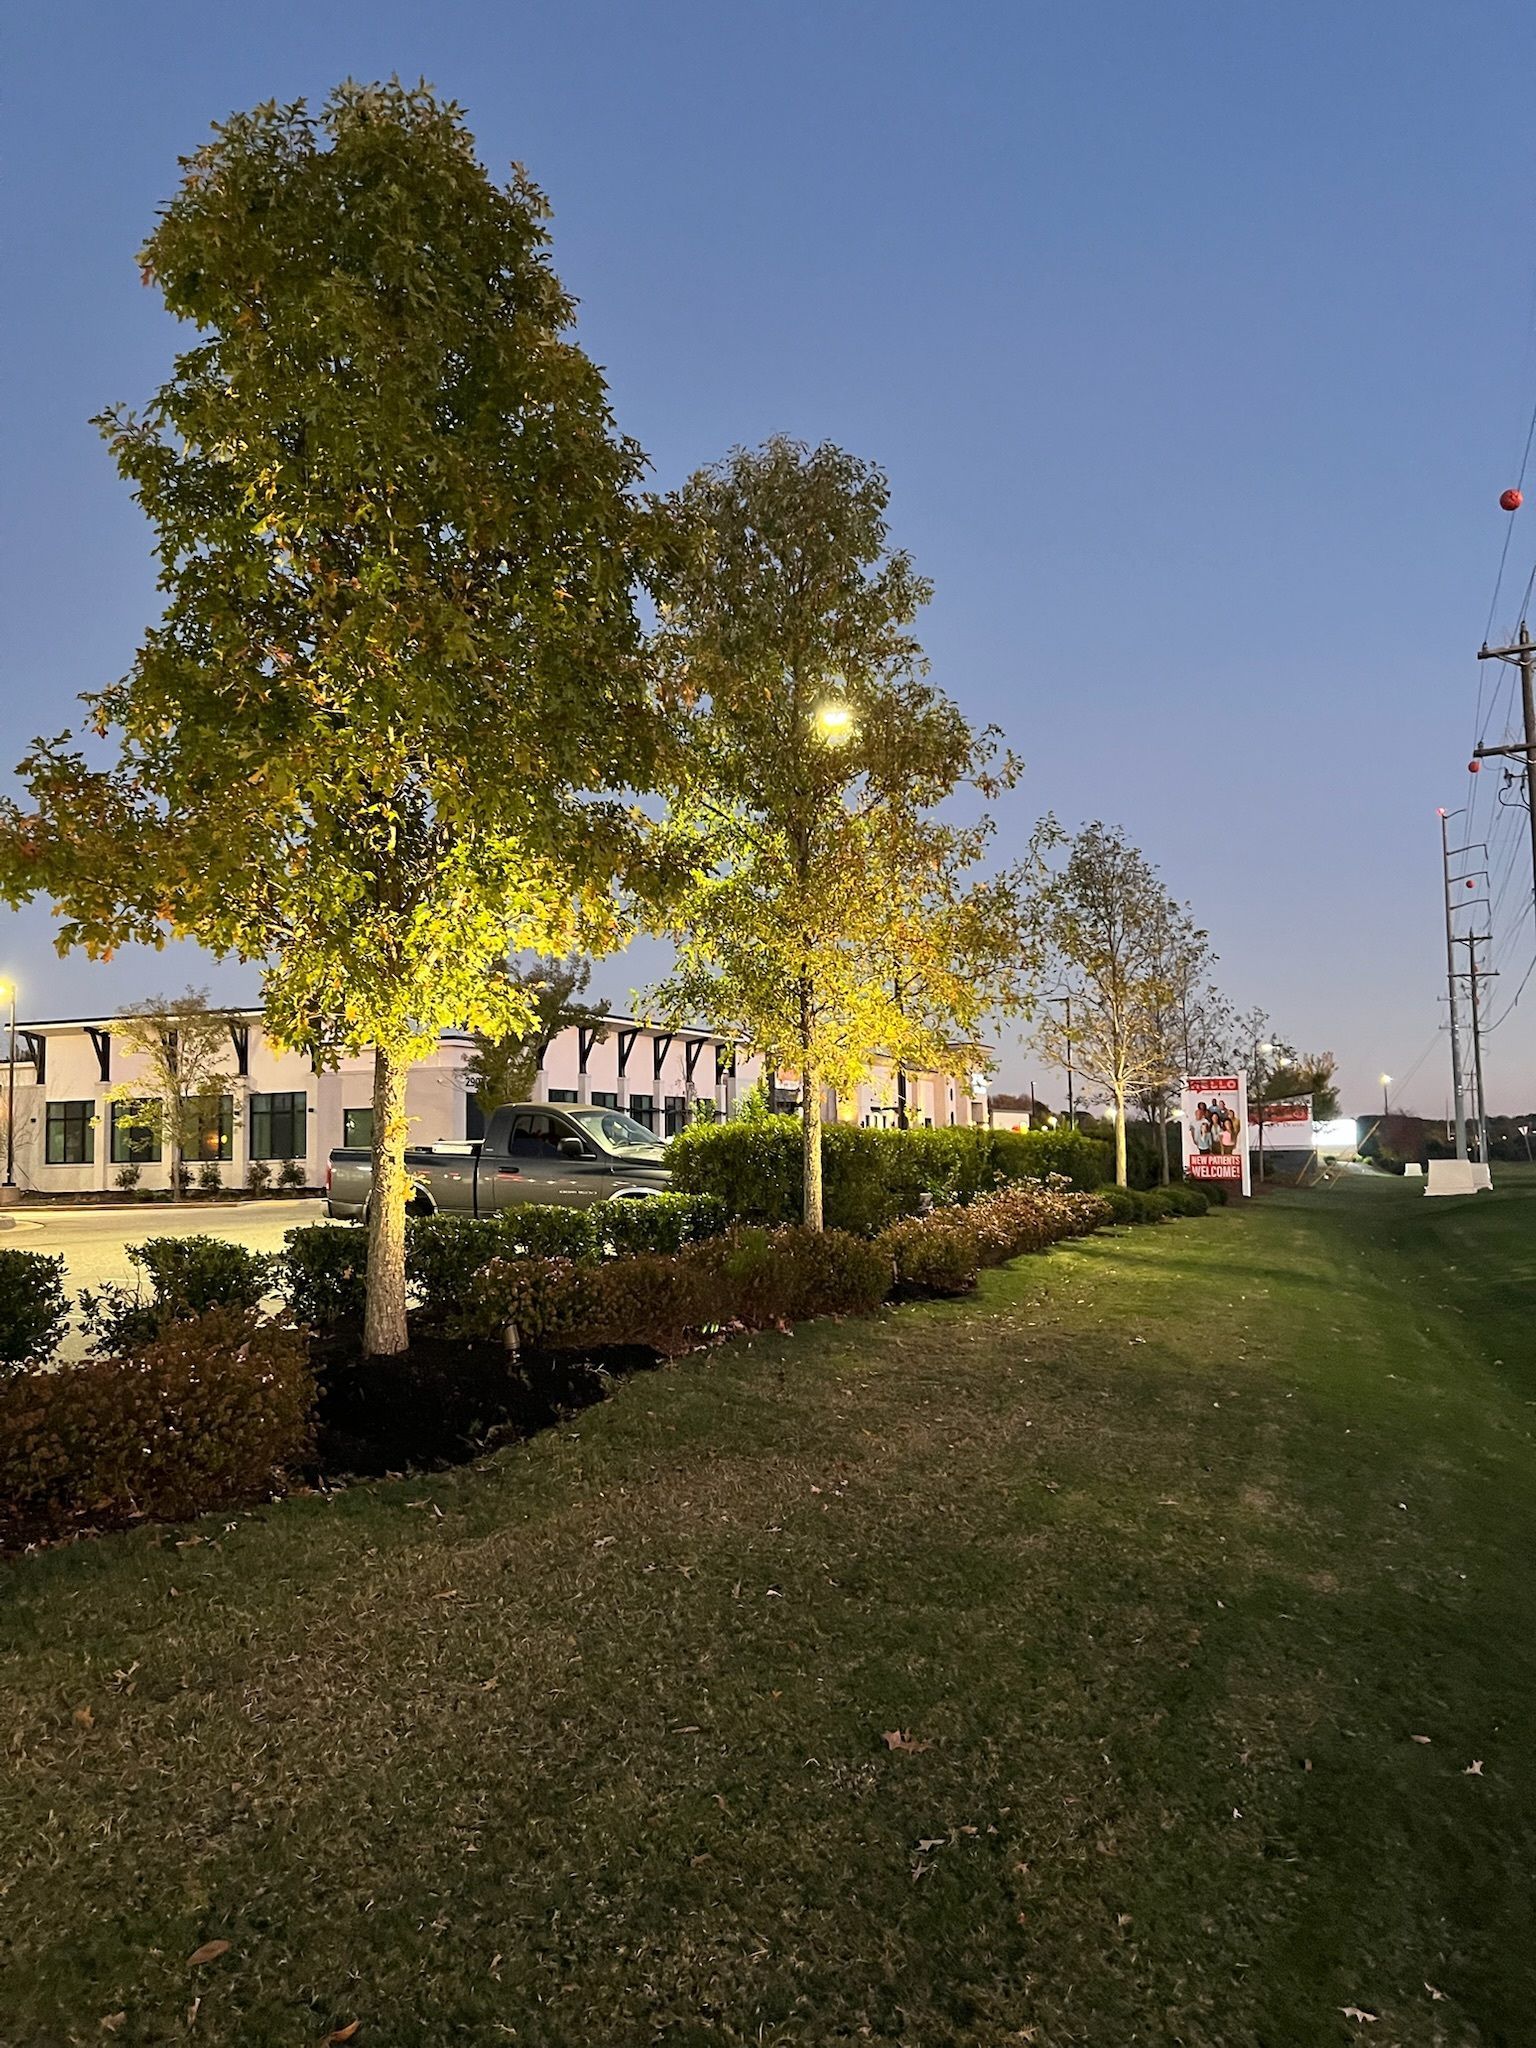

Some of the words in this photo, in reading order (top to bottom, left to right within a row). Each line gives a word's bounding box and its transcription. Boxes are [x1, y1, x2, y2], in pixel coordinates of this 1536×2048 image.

[1191, 1156, 1207, 1165] NEW
[1208, 1155, 1240, 1165] PATIENTS
[1191, 1165, 1241, 1178] WELCOME!
